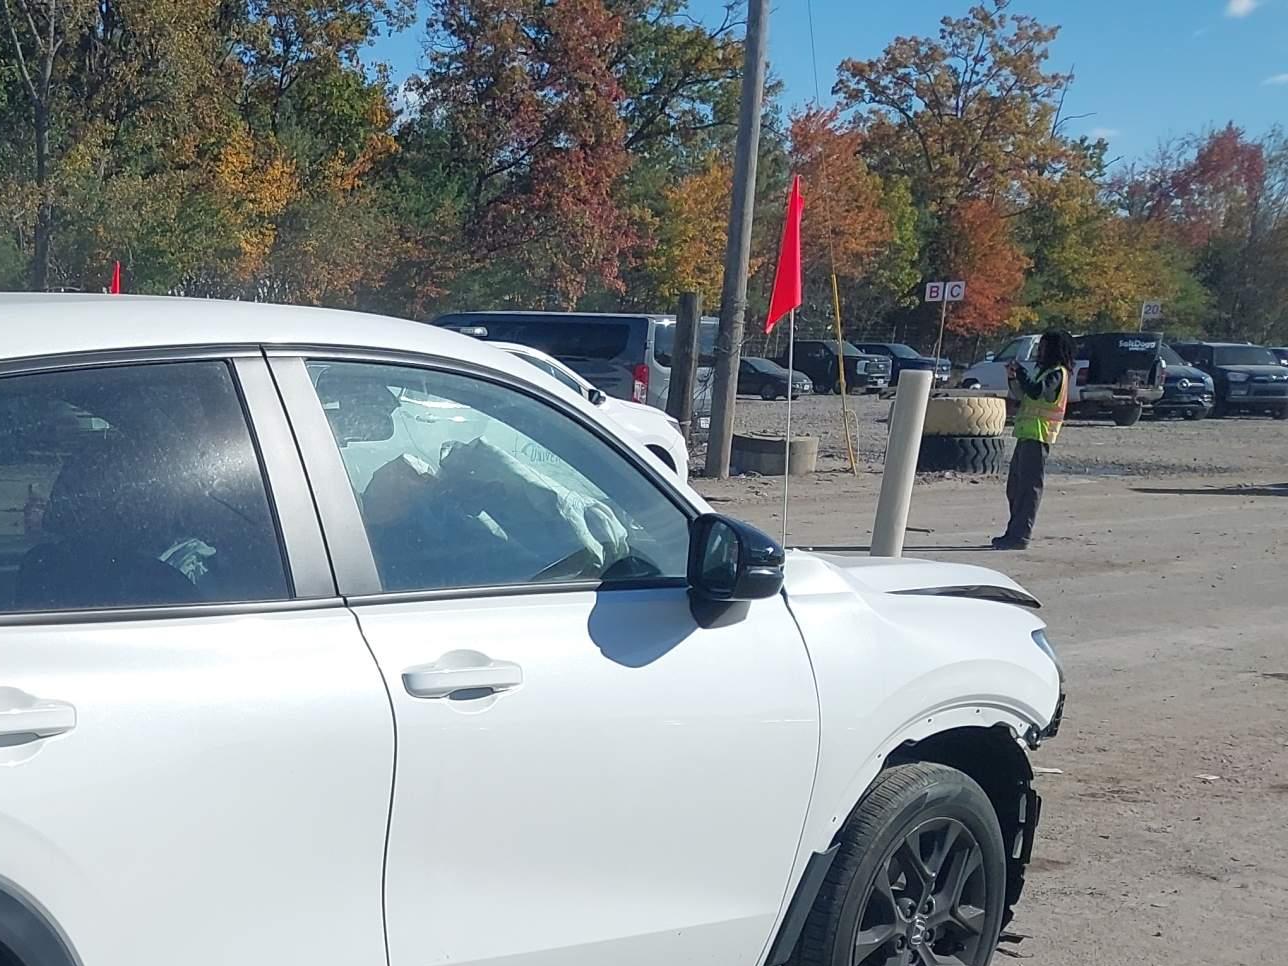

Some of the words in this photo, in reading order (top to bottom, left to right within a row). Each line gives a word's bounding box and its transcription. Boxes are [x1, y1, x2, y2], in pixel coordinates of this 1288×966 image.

[929, 285, 940, 299] B
[950, 284, 962, 298] C
[1144, 304, 1160, 315] 20
